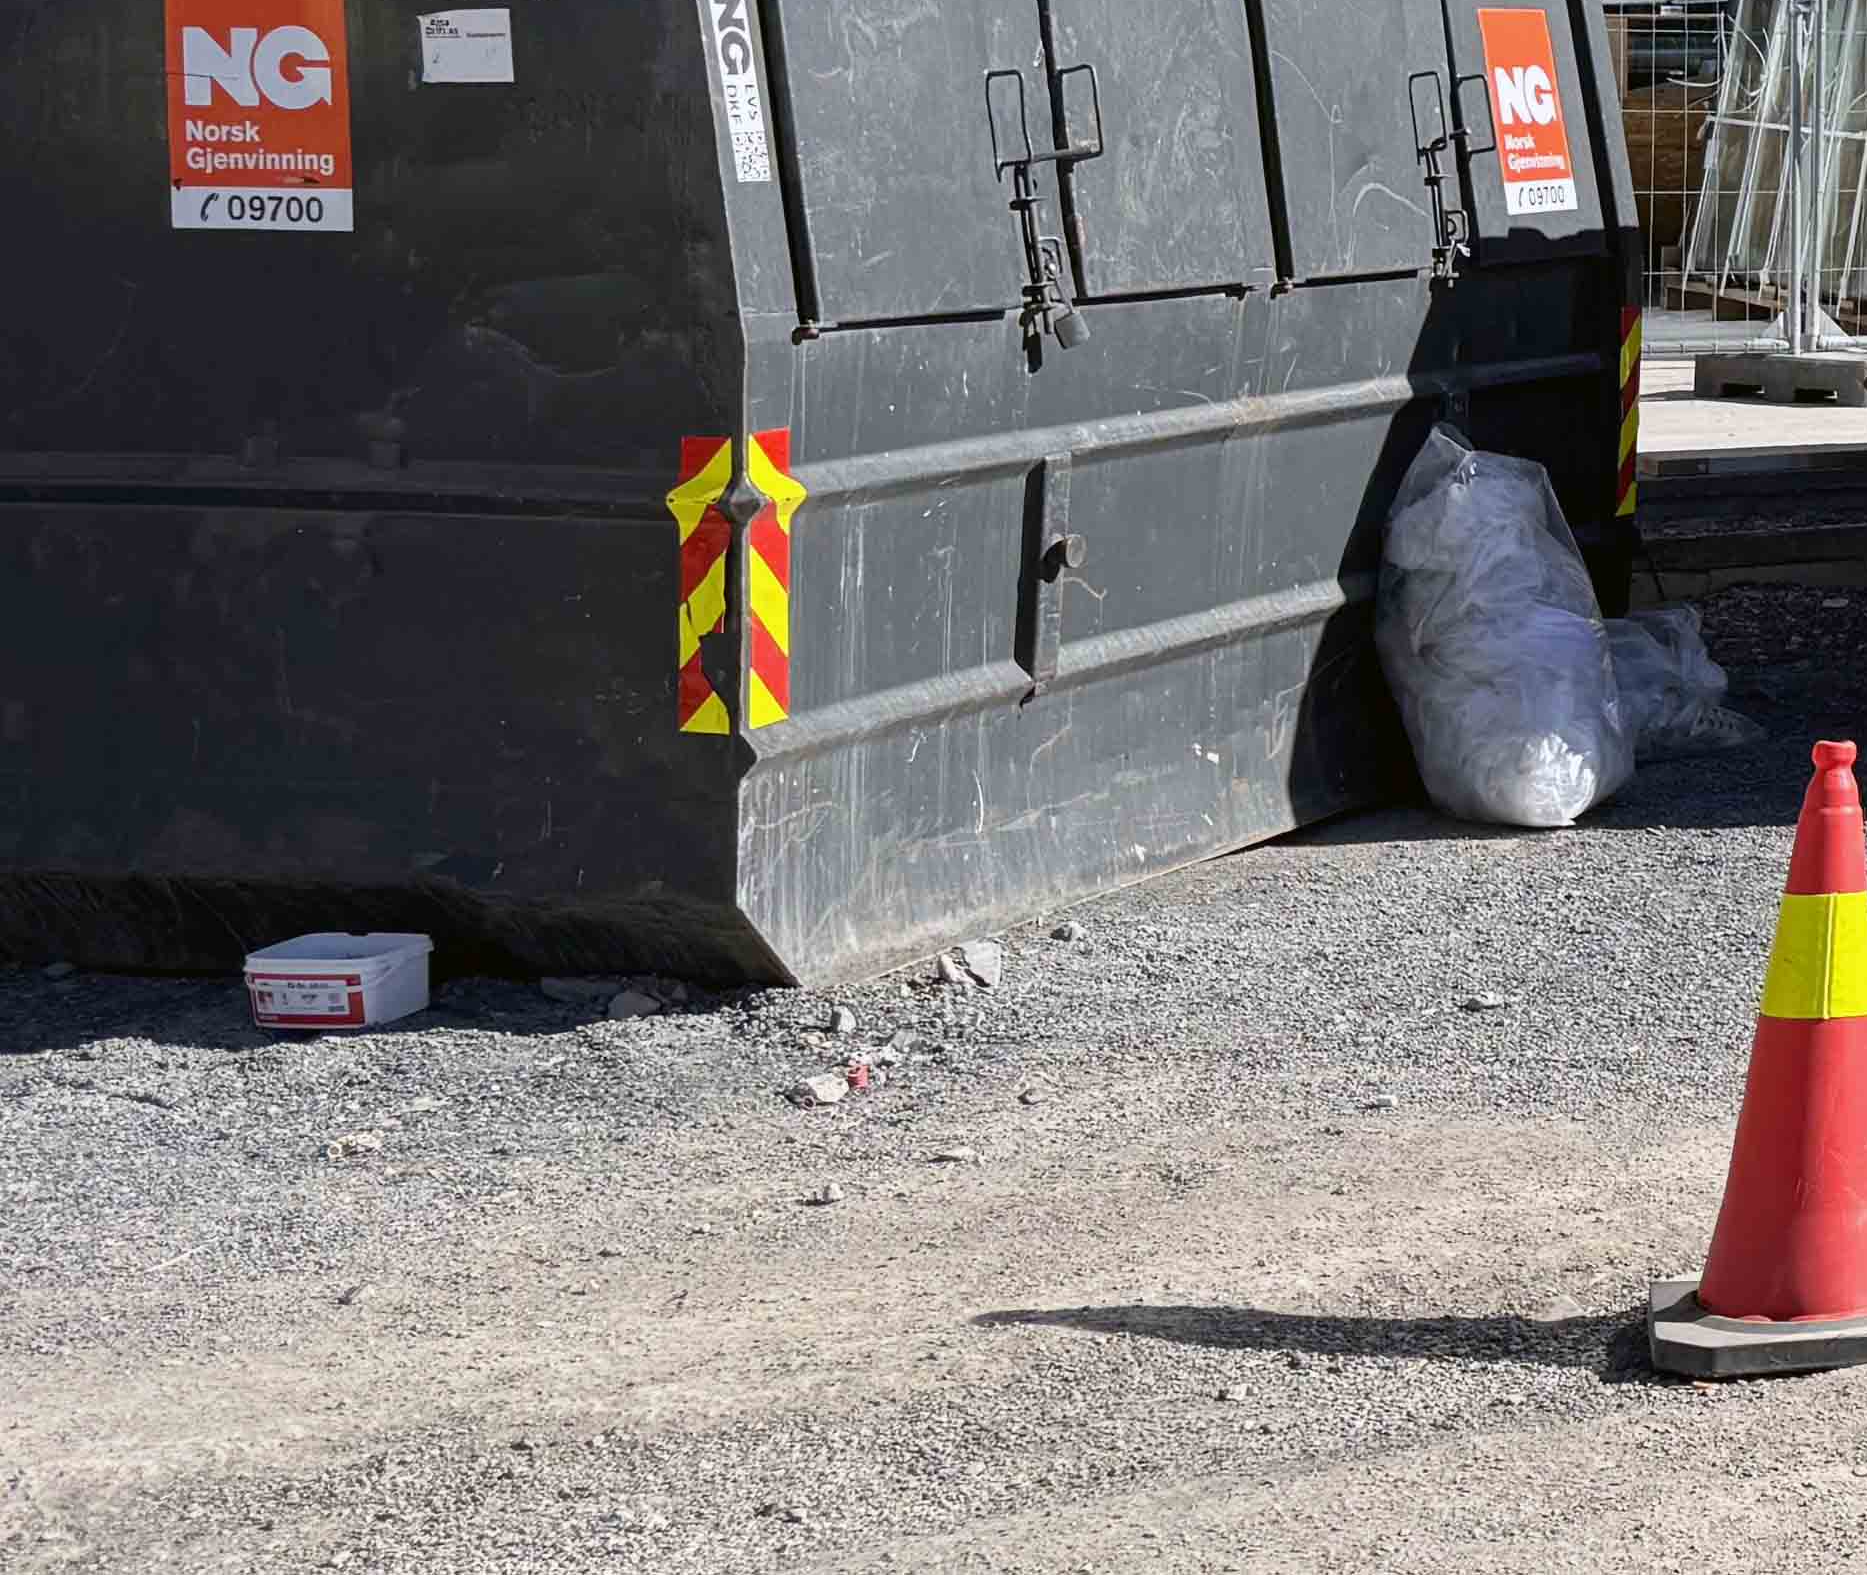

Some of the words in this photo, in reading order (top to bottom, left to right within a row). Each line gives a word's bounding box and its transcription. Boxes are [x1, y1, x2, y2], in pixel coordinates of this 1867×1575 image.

[182, 25, 333, 110] NG
[1494, 65, 1557, 126] NG
[184, 120, 260, 143] Norsk
[1503, 133, 1536, 151] Norsk
[186, 146, 335, 176] Gjenvinning
[227, 194, 324, 223] 09700
[1528, 185, 1565, 207] 09700
